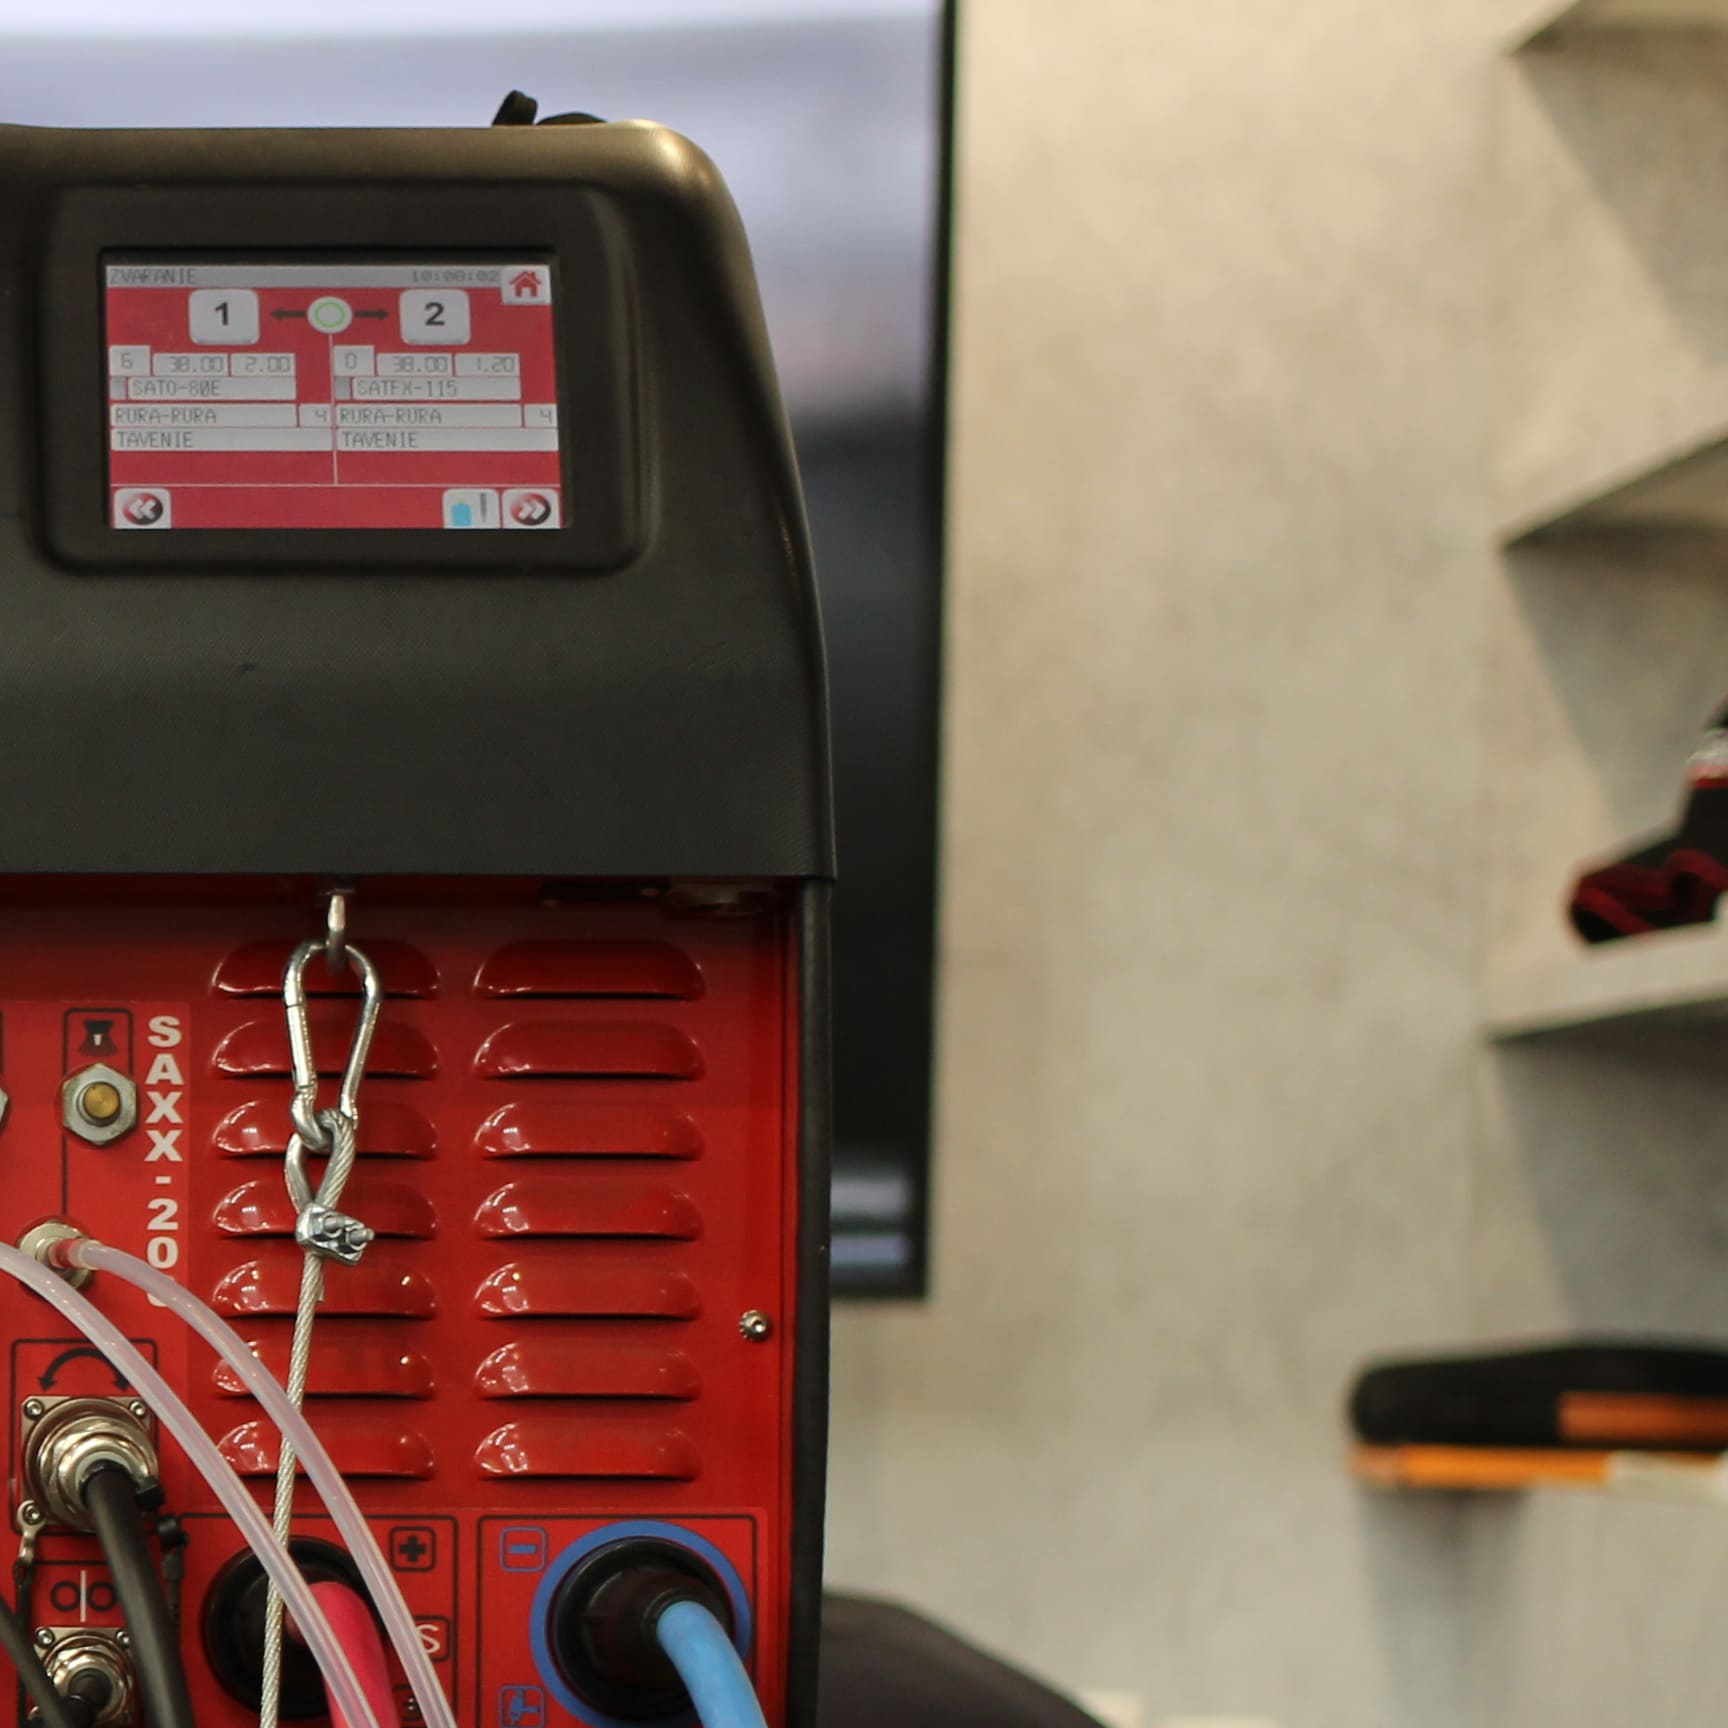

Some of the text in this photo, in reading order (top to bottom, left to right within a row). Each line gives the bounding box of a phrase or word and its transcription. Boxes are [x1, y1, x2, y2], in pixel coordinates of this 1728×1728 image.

[109, 269, 196, 284] ZVARANIE
[214, 301, 230, 327] 1
[424, 301, 446, 327] 2
[120, 353, 291, 373] 6 38.00 2.00
[393, 356, 448, 373] 38.00
[357, 380, 458, 397] SATFX-115
[114, 407, 218, 424] RURA-RURA
[339, 406, 443, 423] RURA-RURA
[117, 431, 193, 449] TAVENIE
[341, 431, 419, 449] TAVENIE
